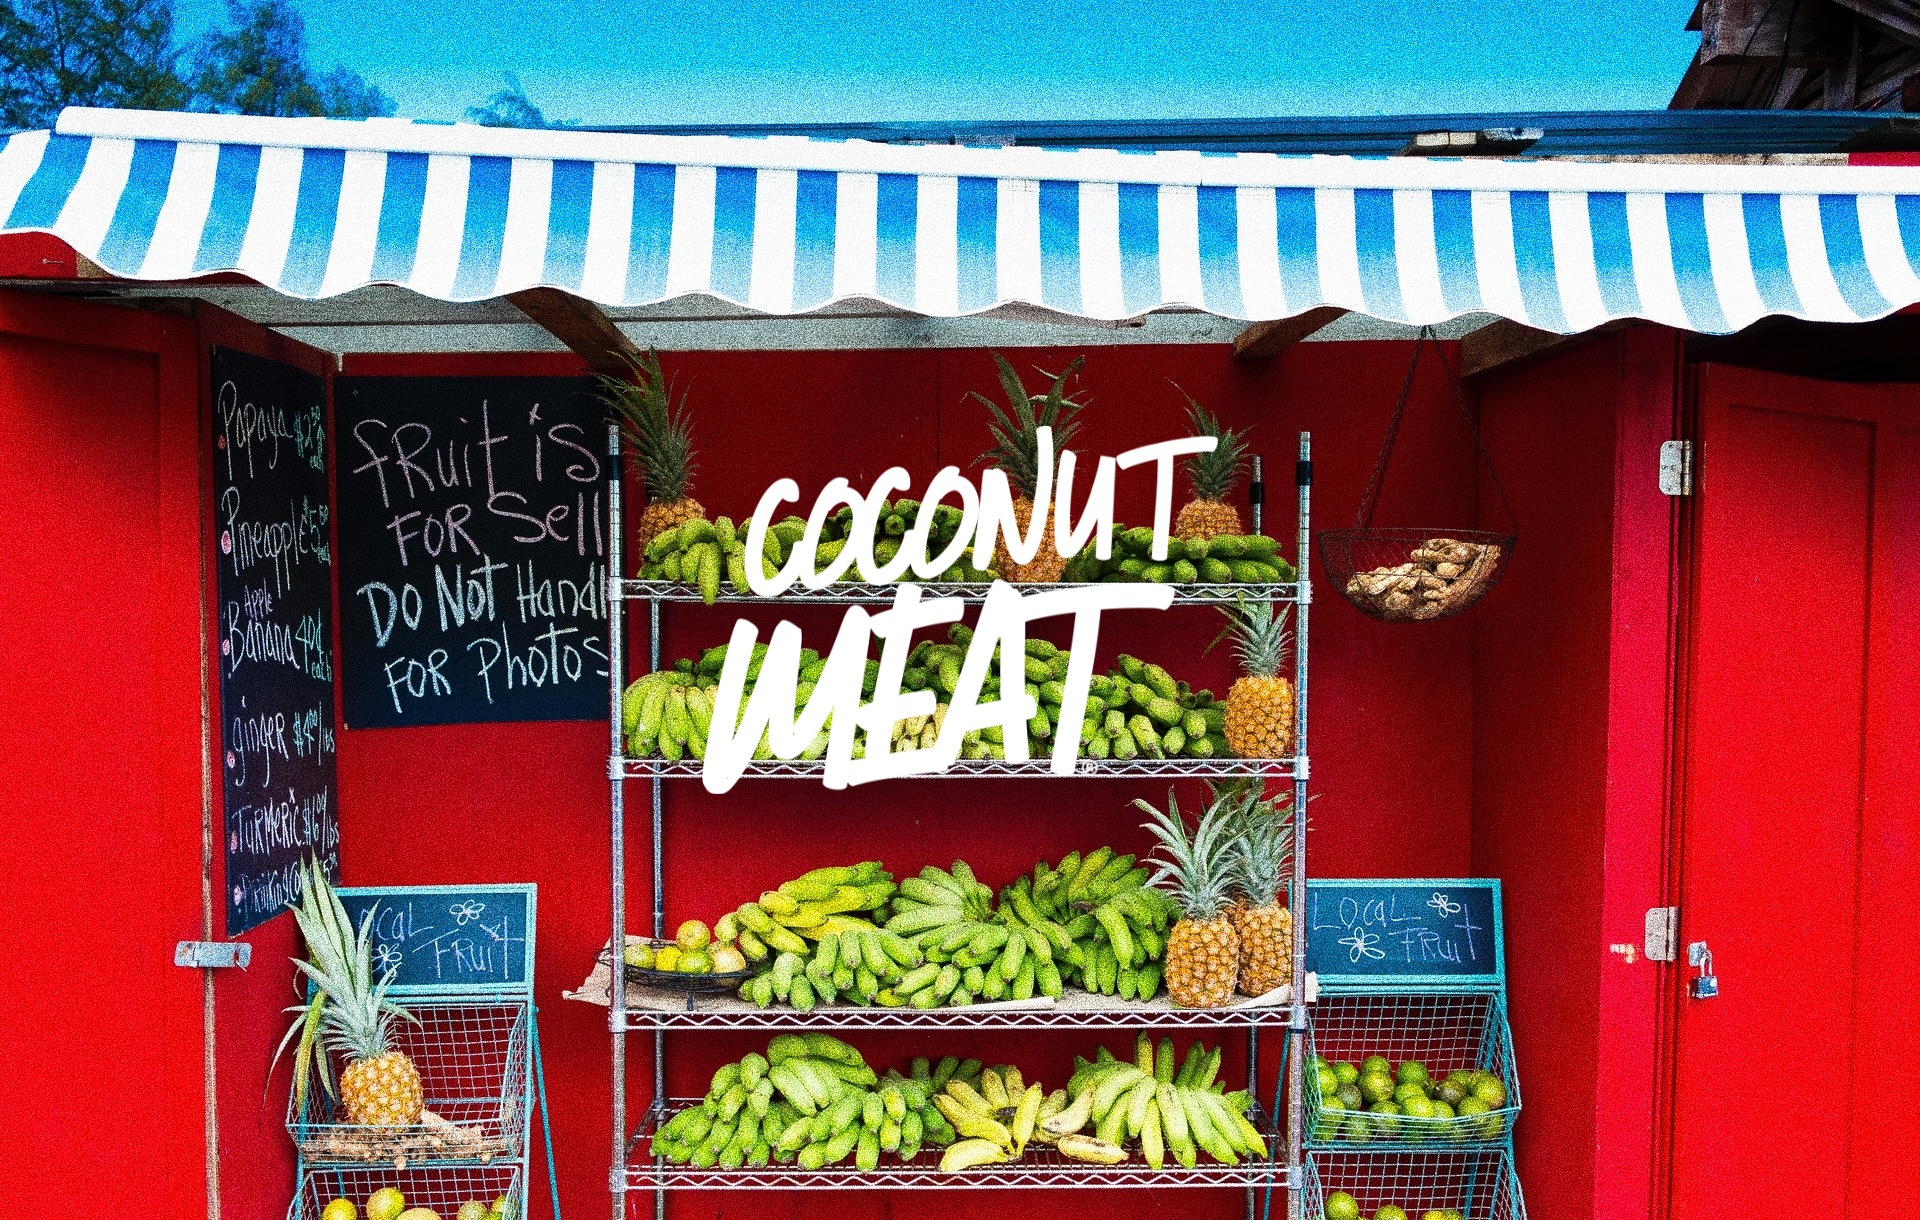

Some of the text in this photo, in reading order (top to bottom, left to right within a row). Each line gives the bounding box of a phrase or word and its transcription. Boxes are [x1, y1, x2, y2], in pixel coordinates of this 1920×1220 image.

[218, 381, 294, 480] Papaya
[529, 402, 601, 482] is
[386, 490, 603, 566] FOR Sell
[223, 600, 300, 673] Banana
[384, 620, 609, 713] FOR Photos
[357, 901, 434, 942] OCaL
